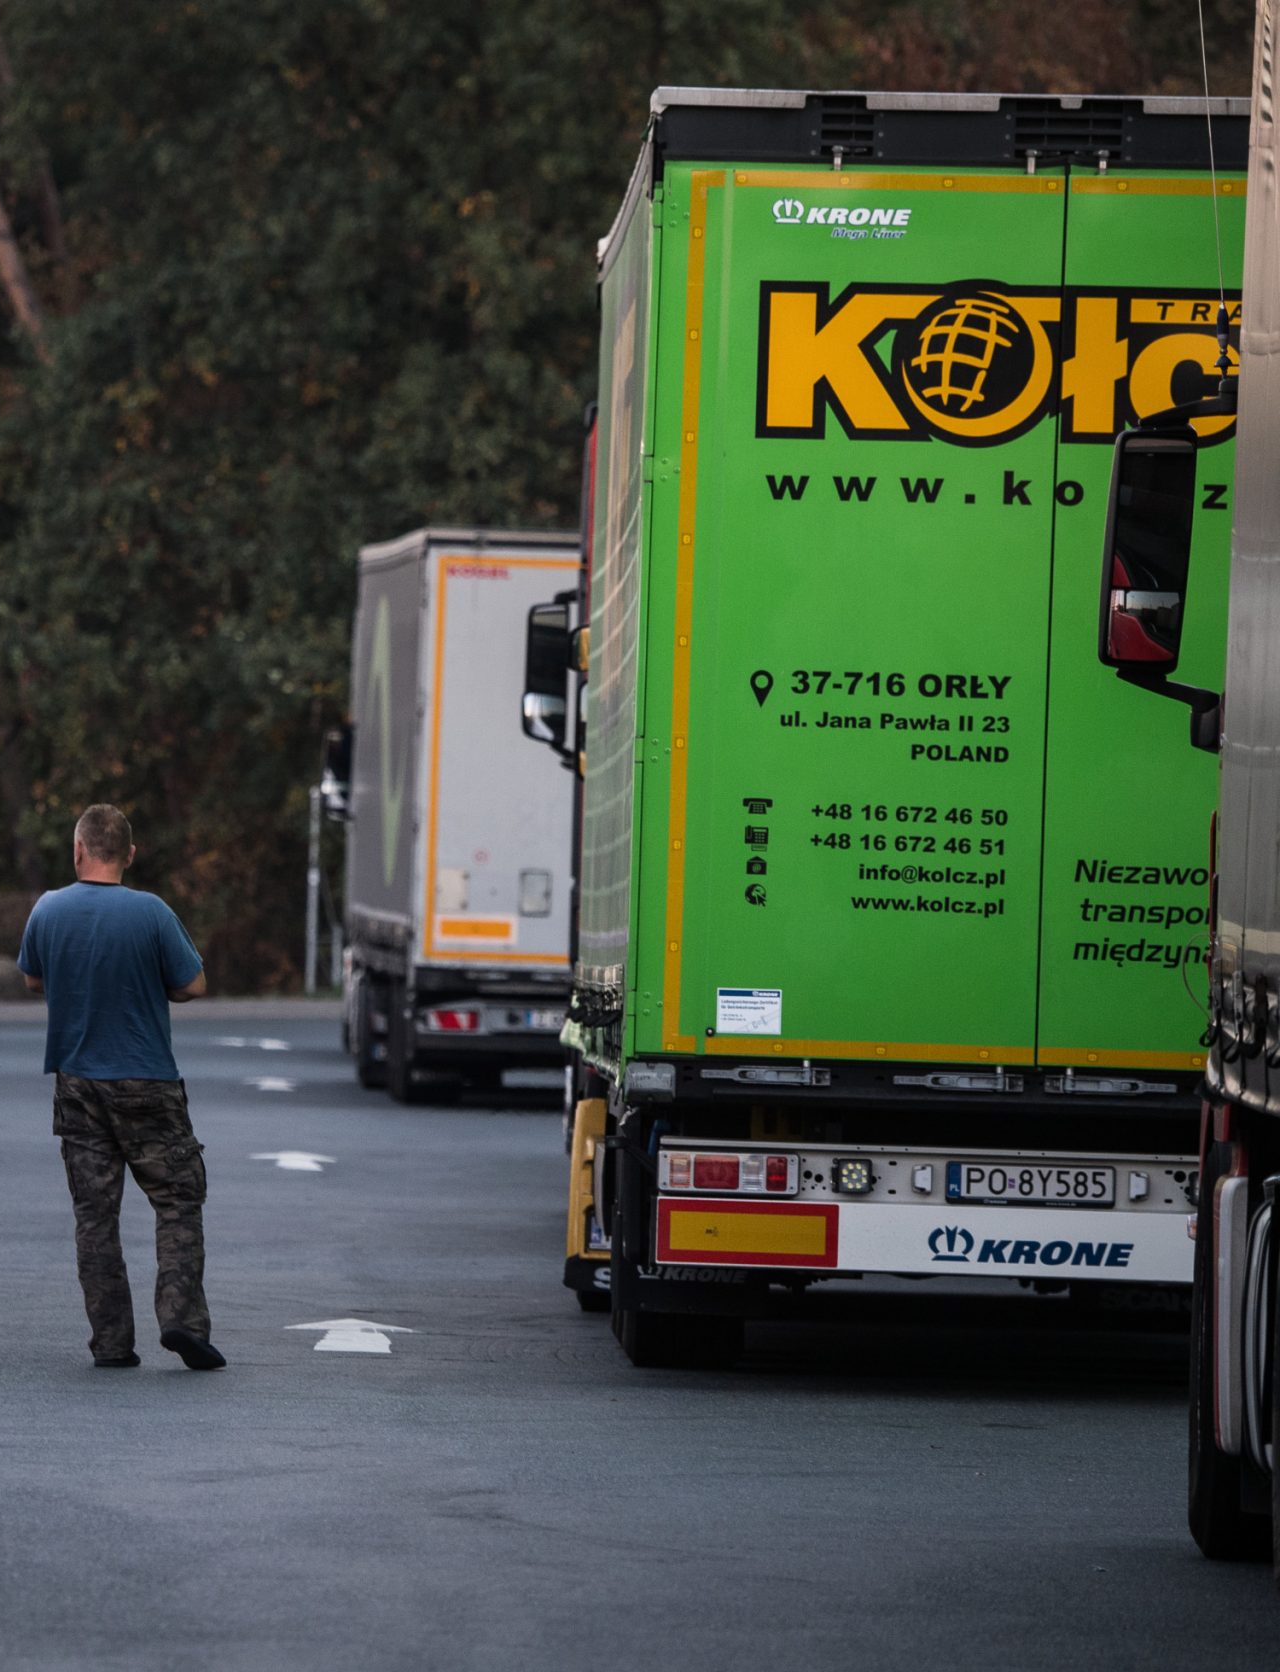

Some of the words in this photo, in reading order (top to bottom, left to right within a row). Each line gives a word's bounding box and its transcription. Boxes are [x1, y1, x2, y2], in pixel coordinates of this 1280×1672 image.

[806, 206, 912, 226] KRONE
[831, 227, 868, 240] Mega
[871, 229, 906, 240] Liner
[791, 670, 906, 697] 37-716
[918, 673, 1012, 699] ORŁY
[780, 711, 808, 728] ul.
[815, 711, 871, 730] Jana
[880, 713, 950, 732] Pawła
[958, 715, 974, 732] II
[982, 716, 1011, 733] 23
[910, 744, 1010, 763] POLAND
[810, 803, 852, 821] +48
[861, 805, 888, 822] 16
[895, 806, 938, 824] 672
[945, 808, 974, 825] 46
[981, 809, 1009, 826] 50
[809, 832, 851, 850] +48
[860, 834, 887, 851] 16
[894, 836, 936, 853] 672
[944, 837, 972, 854] 46
[980, 839, 1005, 856] 51
[858, 863, 1006, 886] info@kolcz.pl
[1074, 859, 1209, 886] Niezawo
[851, 895, 1005, 918] www.kolcz.pl
[966, 1167, 1007, 1195] PO
[1019, 1169, 1106, 1198] 8Y585
[977, 1240, 1134, 1267] KRONE
